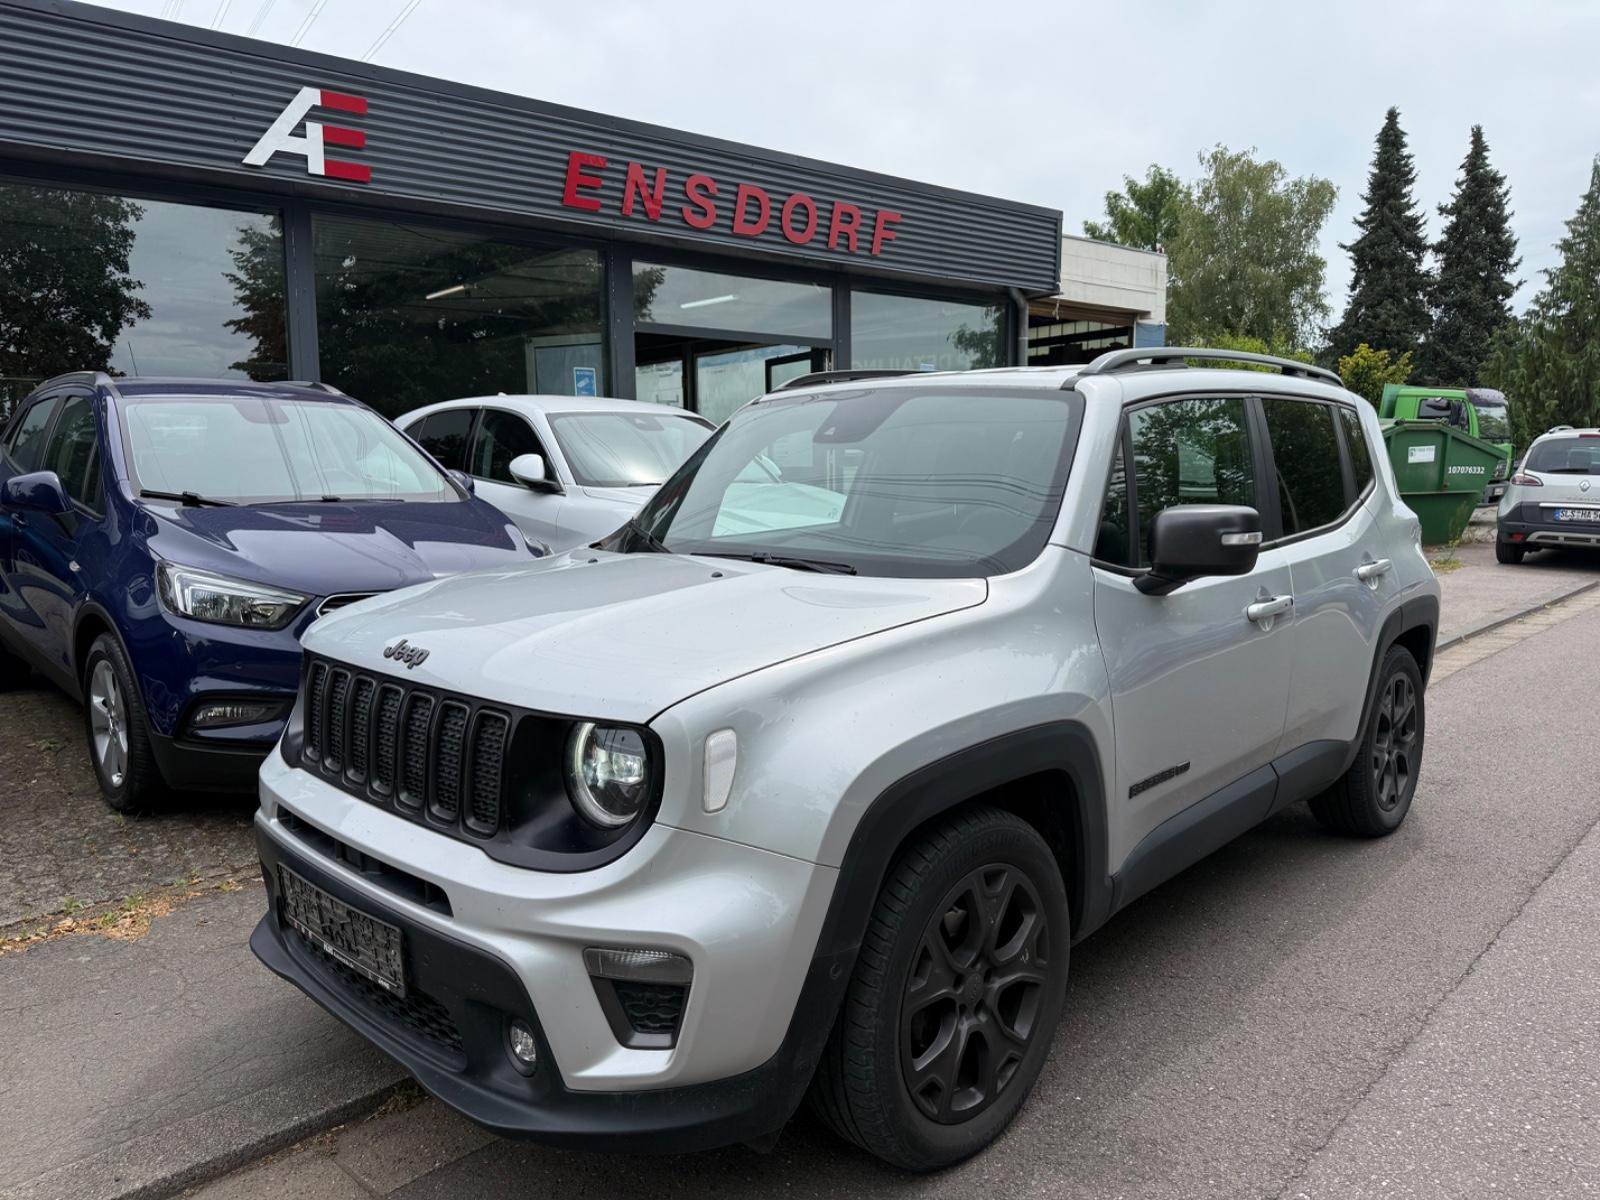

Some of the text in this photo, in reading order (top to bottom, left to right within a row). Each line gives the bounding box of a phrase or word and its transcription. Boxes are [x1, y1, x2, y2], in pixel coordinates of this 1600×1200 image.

[562, 150, 902, 257] ENSDORF
[1448, 466, 1485, 474] 107076332
[383, 639, 430, 670] Jeep
